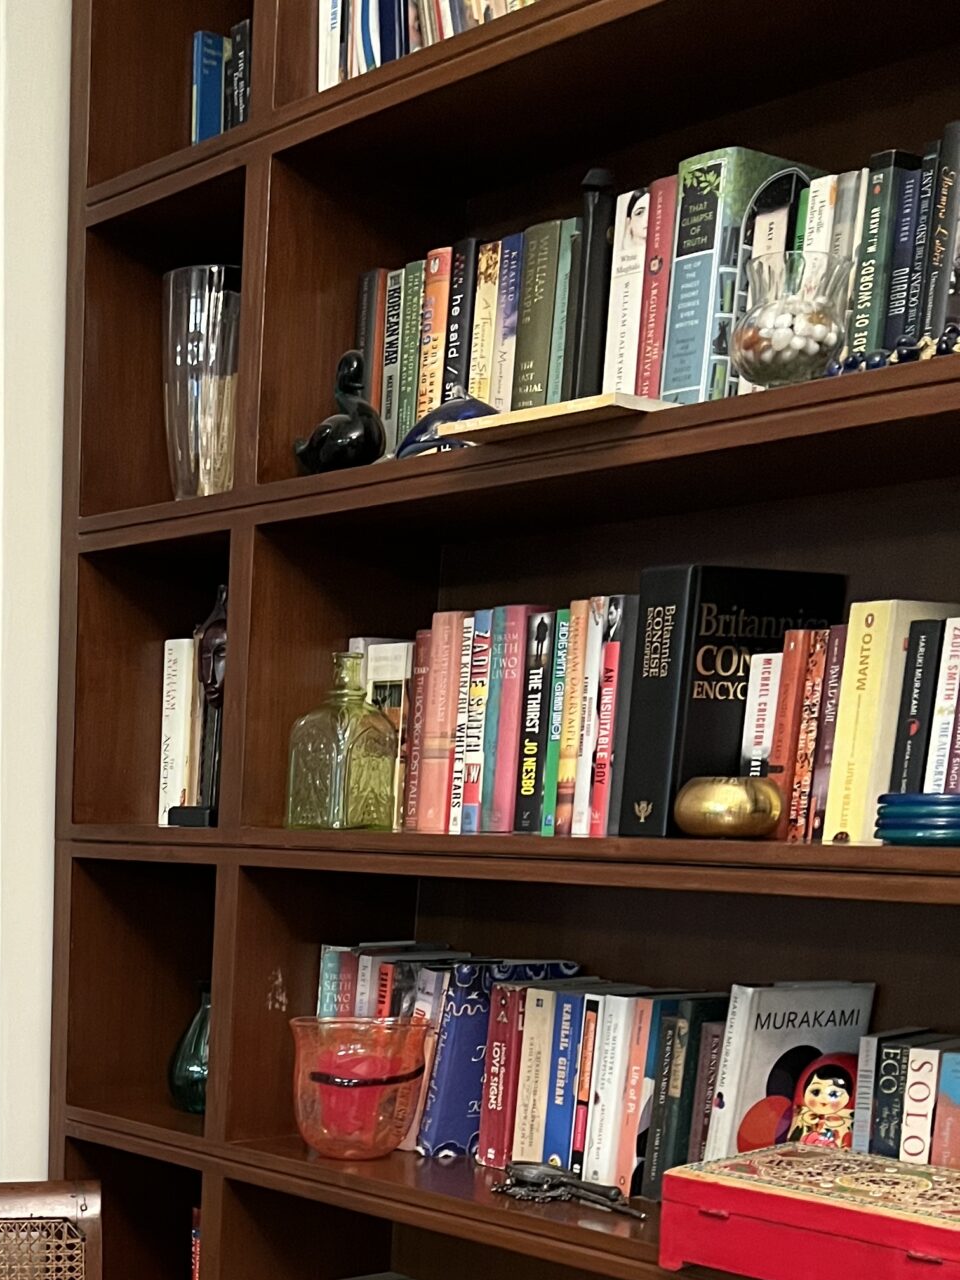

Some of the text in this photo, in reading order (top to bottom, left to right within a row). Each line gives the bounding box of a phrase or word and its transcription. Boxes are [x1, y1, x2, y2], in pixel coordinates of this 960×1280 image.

[681, 211, 714, 228] GLIMPSE
[688, 202, 707, 213] THAT
[690, 226, 701, 236] OF
[683, 236, 708, 249] TRUTH
[909, 169, 934, 306] OCEAN END LANE
[533, 236, 550, 302] WILLIAM
[889, 267, 910, 316] DURBAR
[451, 294, 463, 317] he
[855, 259, 876, 328] OF SWORDS
[384, 287, 401, 366] KOREAN WAR
[645, 281, 659, 378] ARGUMENTATIVE
[493, 642, 518, 654] SETH
[493, 657, 517, 669] TWO
[642, 607, 654, 678] ENCYCLOPEDIA
[648, 606, 664, 678] CONCISE
[659, 605, 677, 679] Britannica
[856, 633, 873, 691] MANTO
[948, 626, 960, 660] ZADIE
[466, 630, 490, 753] ZADIE SMITH
[491, 669, 517, 680] LIVES
[758, 658, 772, 699] MICHAEL
[910, 635, 926, 715] HARUKI MURAKAMI
[944, 665, 958, 701] SMITH
[413, 695, 422, 733] BOOK
[451, 626, 472, 808] HARI KUNZRU WHITE TEARS
[521, 667, 543, 796] THE THIRST JO NESBO
[566, 676, 578, 751] DALRYMPLE
[595, 667, 614, 784] AN UNSUITABLE BOY
[753, 701, 769, 747] CRICHTON
[941, 721, 951, 740] THE
[161, 734, 171, 794] ANARCHY
[411, 747, 420, 778] LOST
[949, 757, 960, 789] SINGH
[408, 779, 417, 816] TALES
[322, 1003, 351, 1012] LIVES
[323, 981, 352, 990] SETH
[324, 993, 351, 1003] TWO
[559, 1003, 572, 1051] KAHLIL
[754, 1008, 861, 1032] MURAKAMI
[488, 1041, 501, 1110] LOVE SIGNS
[554, 1056, 567, 1105] GIBRAN
[719, 1035, 732, 1088] MURAKAMI
[879, 1049, 902, 1095] ECO
[627, 1065, 640, 1115] Life of Pi
[902, 1059, 933, 1157] SOLO
